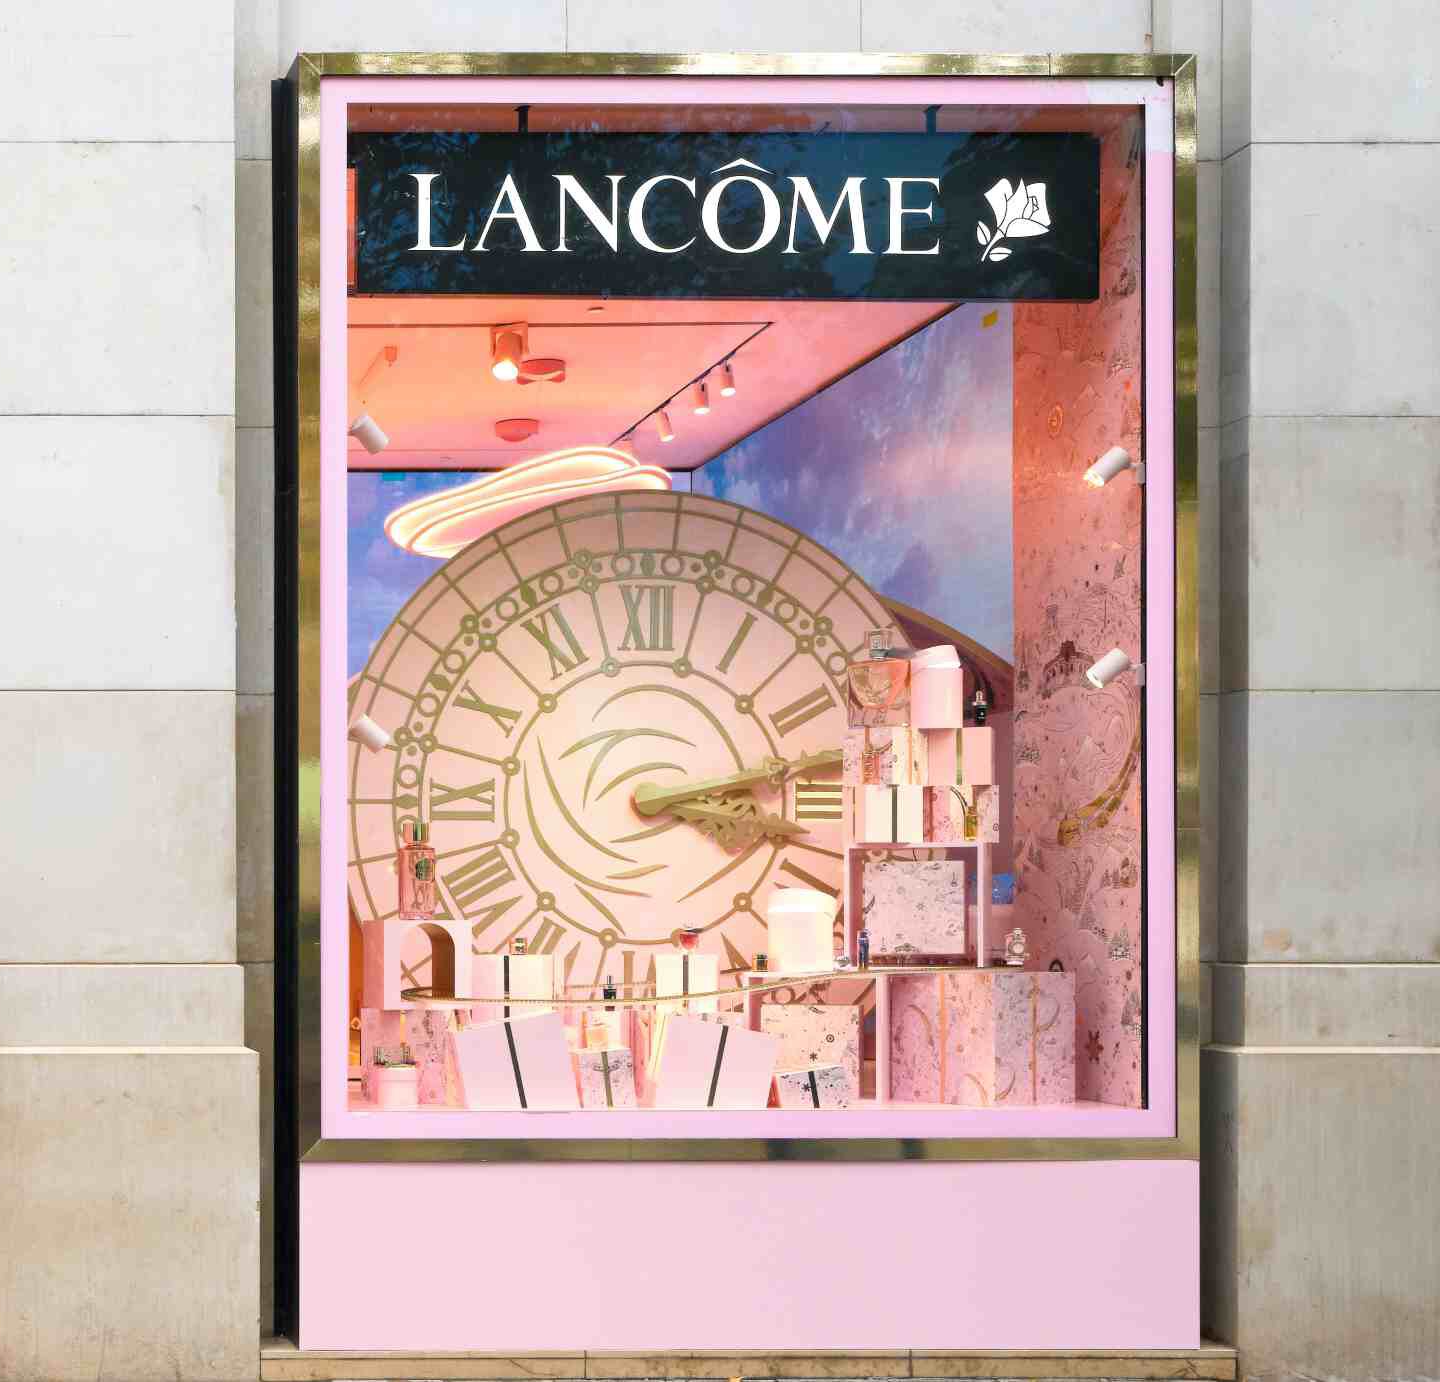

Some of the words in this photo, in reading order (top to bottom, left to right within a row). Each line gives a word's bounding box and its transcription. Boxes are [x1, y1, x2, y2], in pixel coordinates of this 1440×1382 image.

[407, 157, 941, 256] LANCÔME
[522, 602, 590, 681] XI
[617, 584, 676, 652] XII
[717, 611, 759, 674] I
[453, 682, 523, 738] X
[768, 682, 838, 739] II
[429, 776, 496, 824] IX
